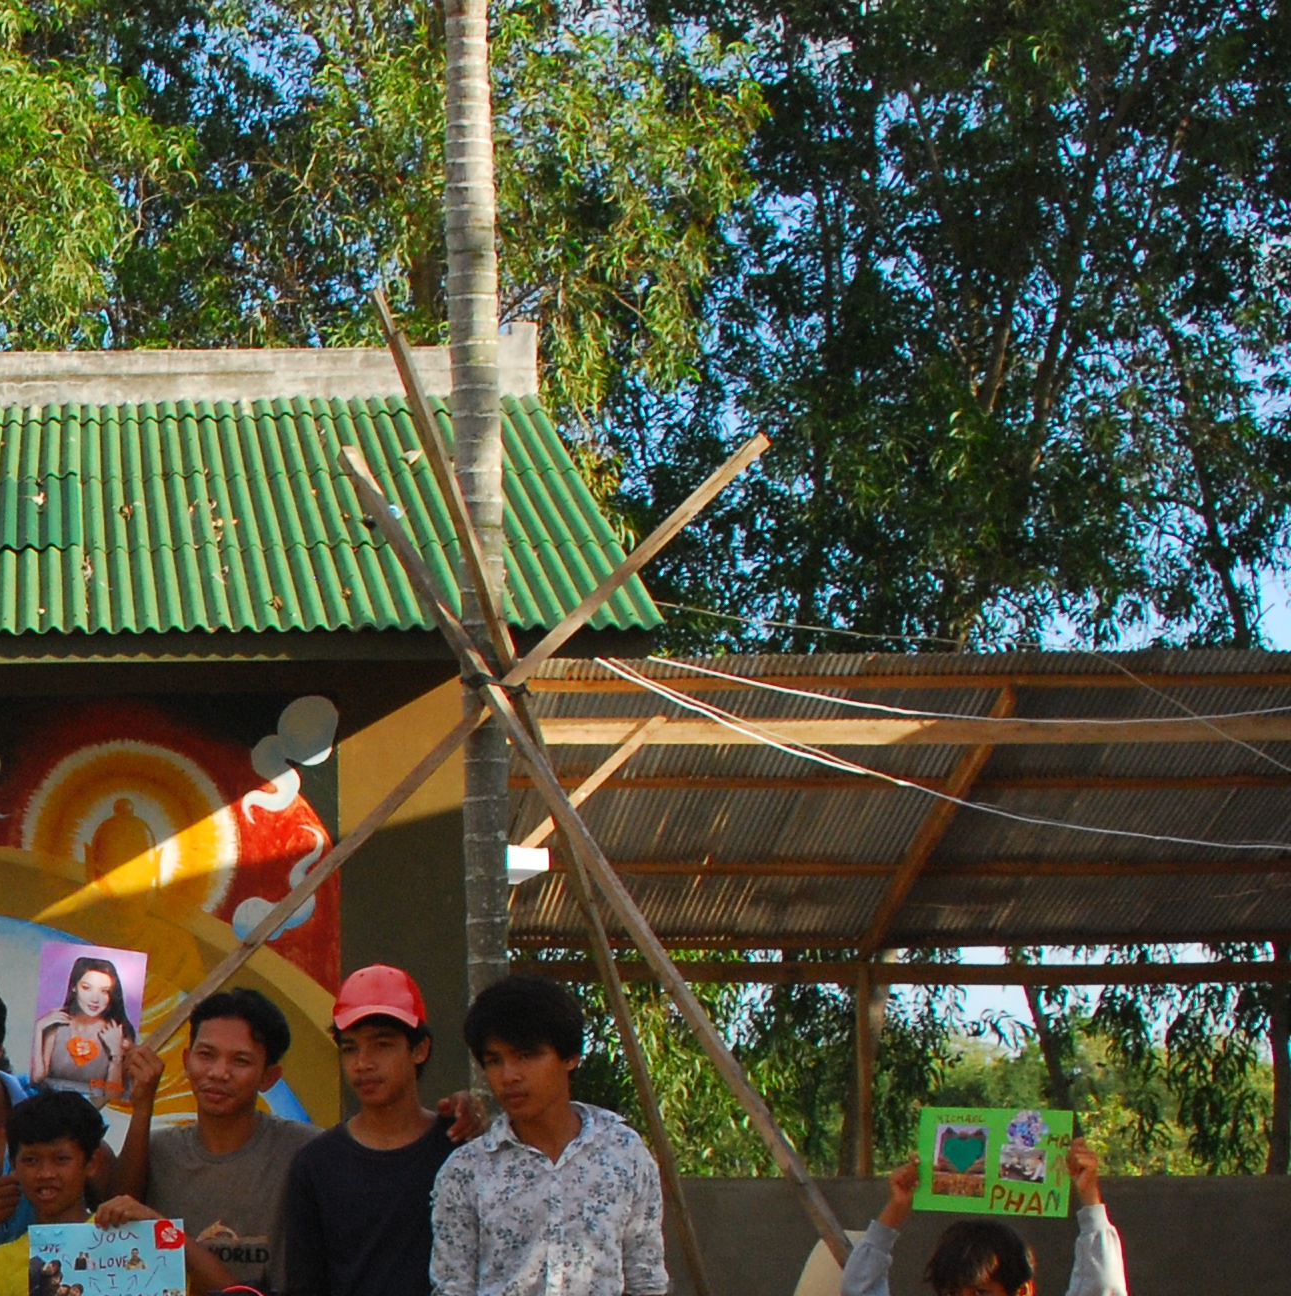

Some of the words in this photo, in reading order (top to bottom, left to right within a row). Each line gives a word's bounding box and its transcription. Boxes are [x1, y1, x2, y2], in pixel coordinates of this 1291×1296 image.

[989, 1184, 1061, 1215] PHAN
[98, 1255, 128, 1270] LOVE
[106, 1273, 118, 1289] I
